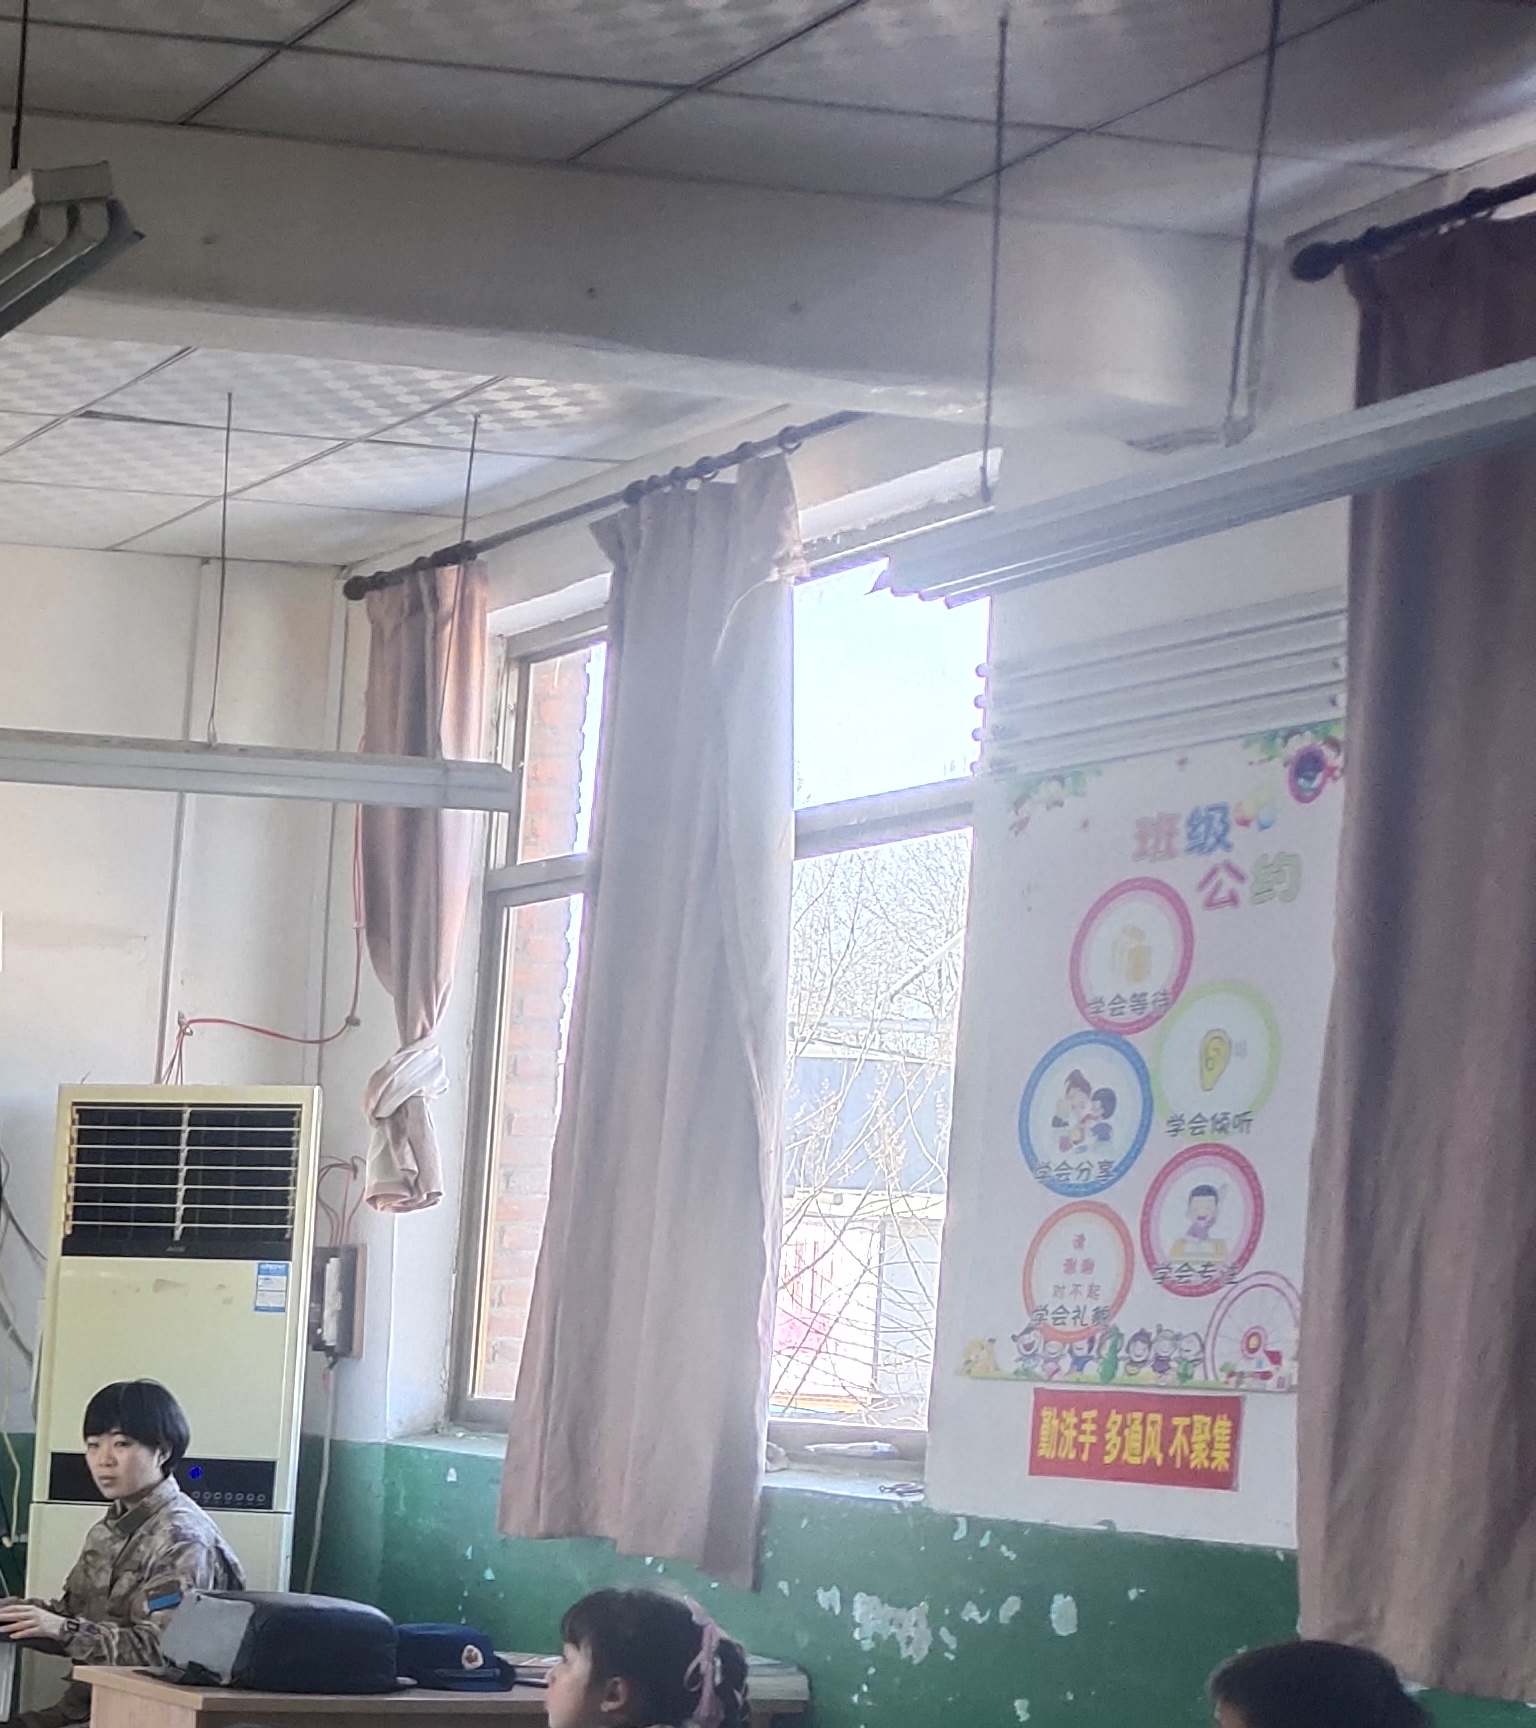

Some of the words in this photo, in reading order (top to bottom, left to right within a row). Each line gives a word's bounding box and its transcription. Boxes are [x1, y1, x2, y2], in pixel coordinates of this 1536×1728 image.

[1131, 801, 1234, 862] 班级
[1196, 851, 1303, 911] 公约
[1086, 988, 1175, 1018] 学会等待
[1165, 1111, 1254, 1138] 学会倾听
[1034, 1158, 1117, 1184] 学会分享
[1037, 1405, 1098, 1462] 勤洗手
[1102, 1408, 1164, 1468] 多通风
[1167, 1413, 1233, 1473] 不聚集
